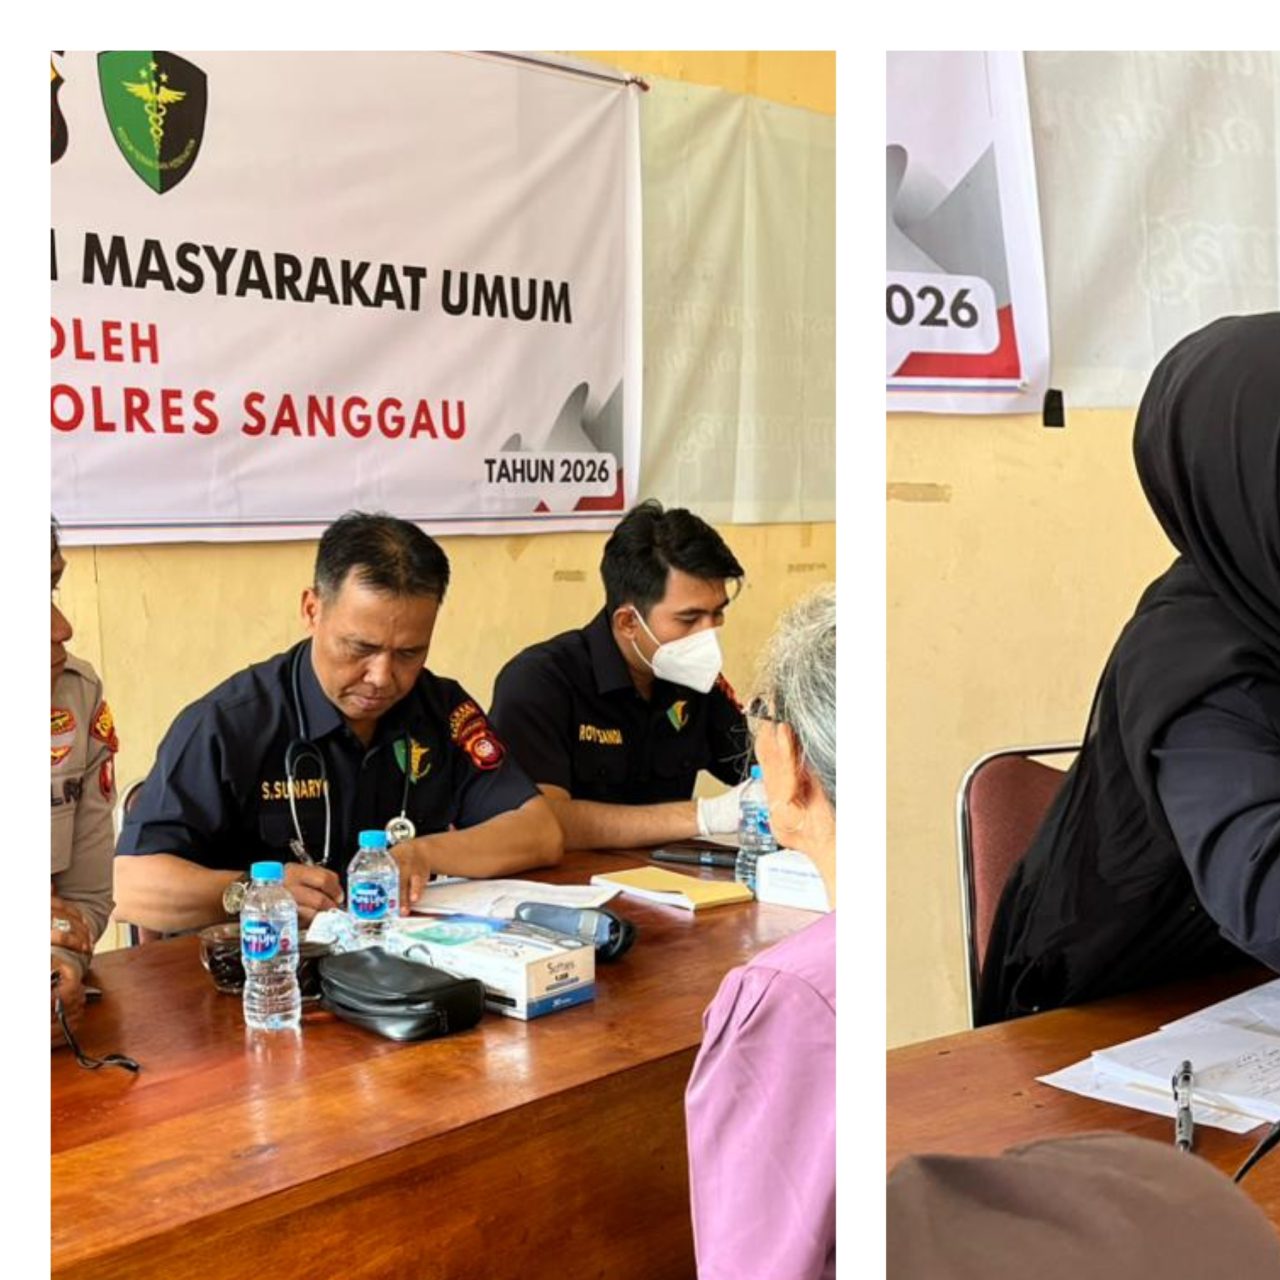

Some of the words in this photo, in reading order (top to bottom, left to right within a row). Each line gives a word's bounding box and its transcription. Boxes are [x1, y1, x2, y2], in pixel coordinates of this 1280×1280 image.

[82, 232, 427, 310] MASYARAKAT
[441, 269, 572, 324] UMUM
[51, 384, 219, 435] OLRES
[242, 391, 466, 440] SANGGAU
[484, 459, 554, 483] TAHUN
[560, 459, 610, 483] 2026
